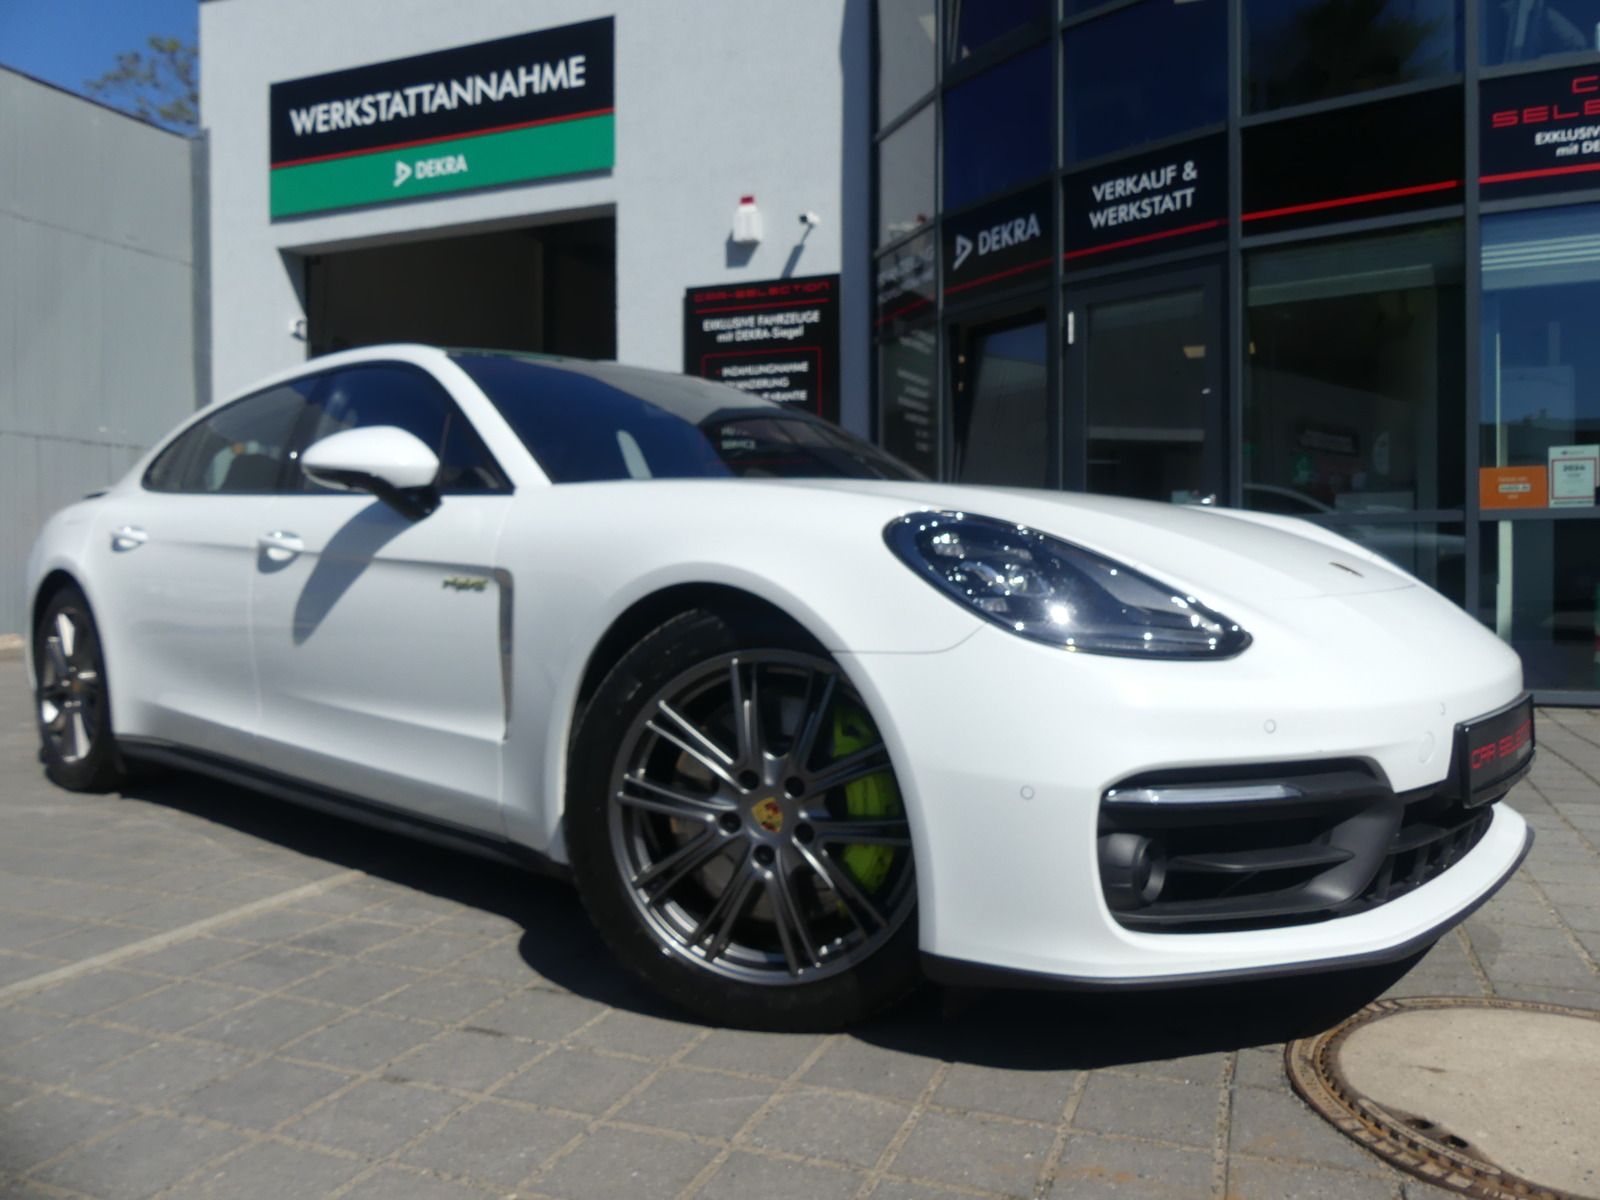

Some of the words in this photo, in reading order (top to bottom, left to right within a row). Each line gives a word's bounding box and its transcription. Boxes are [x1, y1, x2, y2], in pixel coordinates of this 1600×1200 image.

[289, 55, 586, 135] WERKSTATTANNAHME
[414, 155, 468, 179] DEKRA
[1092, 165, 1177, 202] VERKAUF
[1182, 160, 1197, 181] &
[1089, 187, 1196, 229] WERKSTATT
[977, 213, 1041, 256] DEKRA
